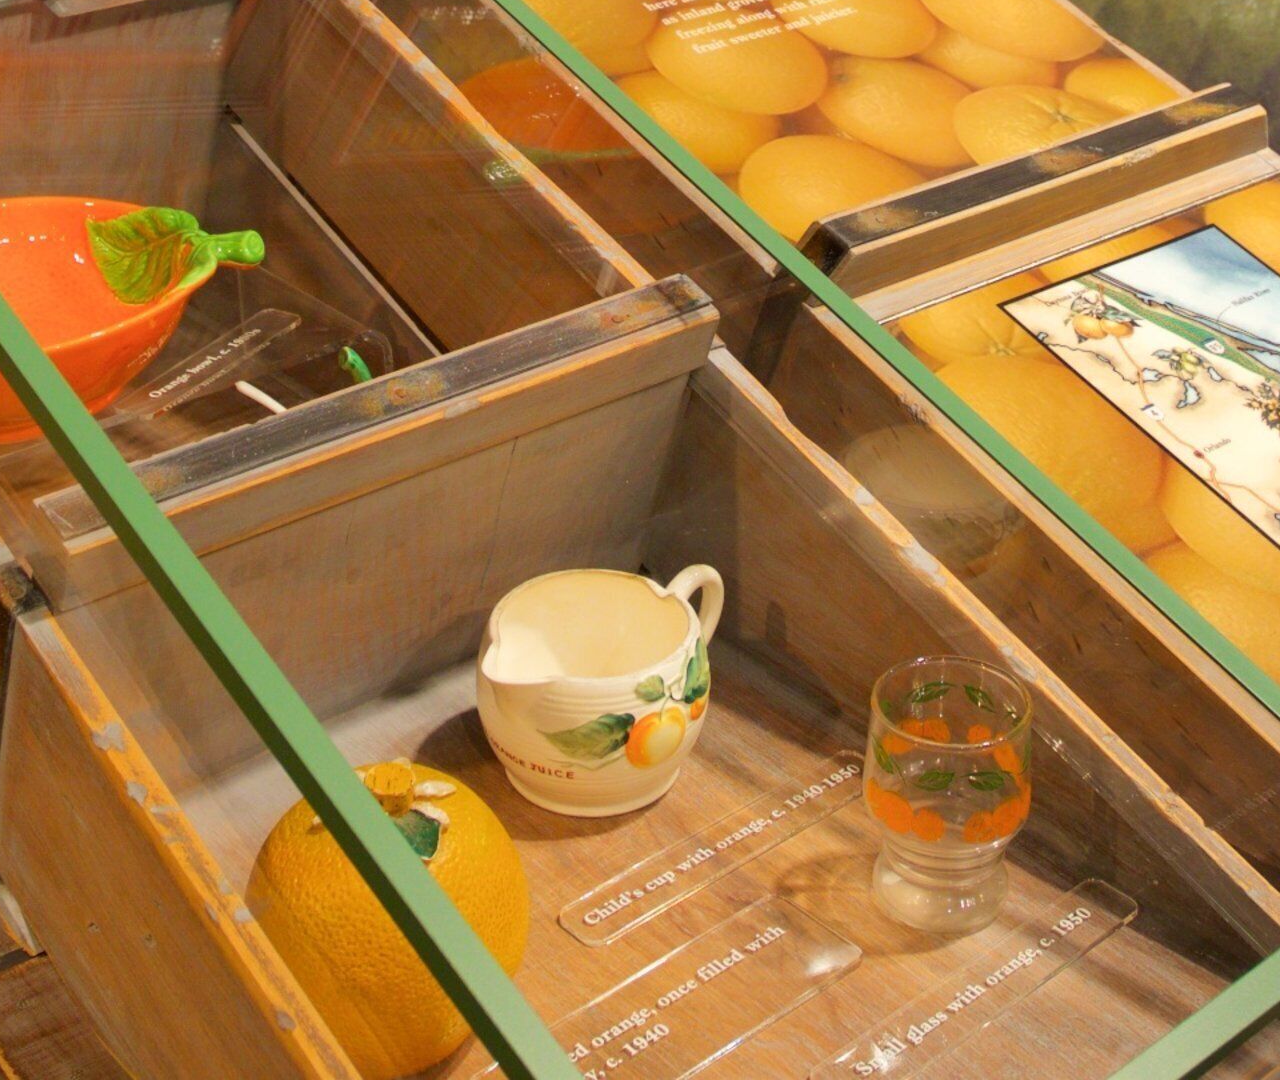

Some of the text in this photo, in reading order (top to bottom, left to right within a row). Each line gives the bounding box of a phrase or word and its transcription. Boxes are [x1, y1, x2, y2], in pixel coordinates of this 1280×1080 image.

[530, 762, 575, 780] JUICE
[582, 763, 861, 925] Child's cup with orange, c. 1940-1950
[589, 922, 787, 1048] orange, once filled with
[906, 1012, 948, 1044] glass
[946, 981, 988, 1013] with
[985, 950, 1043, 986] orange,
[1038, 938, 1055, 947] c.
[1051, 906, 1091, 935] 1950
[605, 1022, 670, 1067] c. 1940
